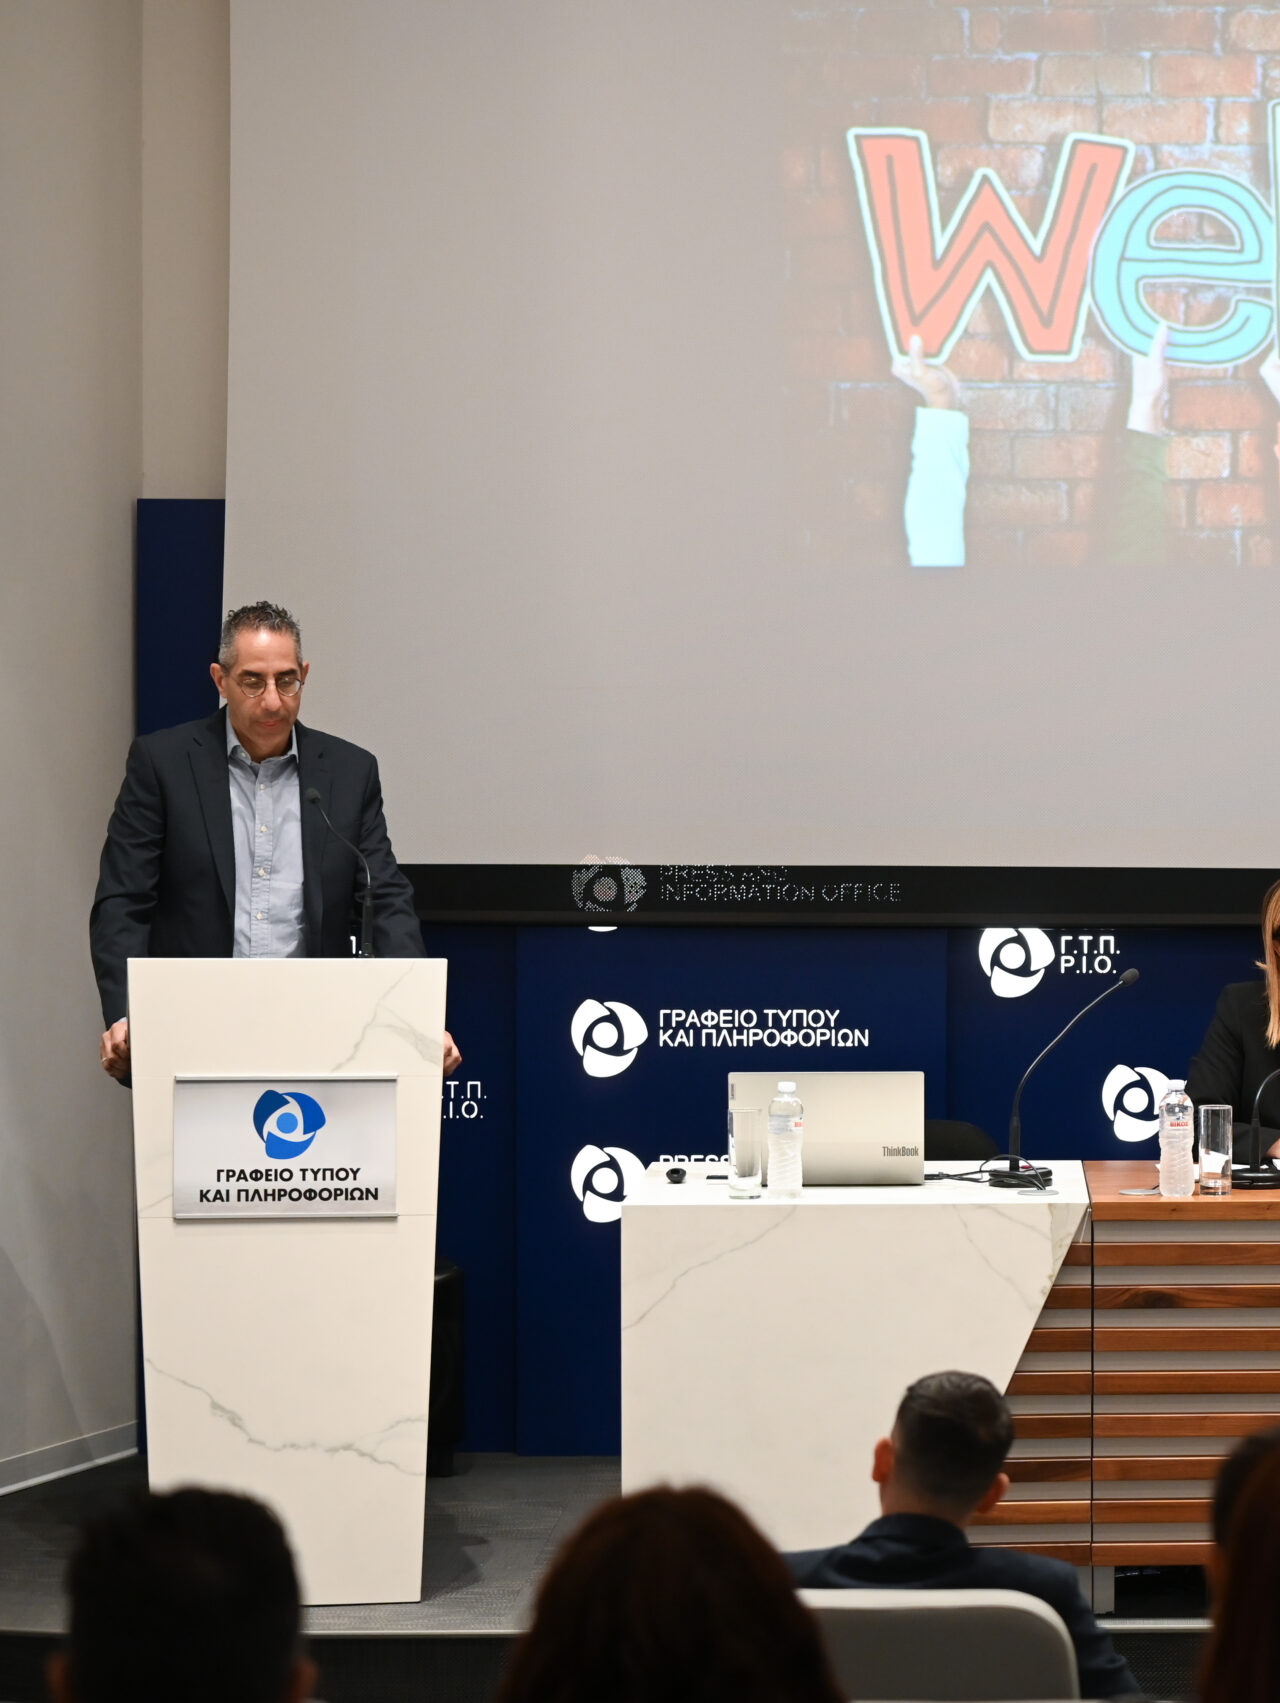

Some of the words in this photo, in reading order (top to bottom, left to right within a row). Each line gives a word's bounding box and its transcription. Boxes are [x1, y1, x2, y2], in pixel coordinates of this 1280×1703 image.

[1060, 935, 1120, 955] Γ.Τ.Π.
[1060, 955, 1117, 974] P.I.O.
[659, 1008, 758, 1028] ΓΡΑΦΕΙΟ
[763, 1008, 840, 1028] ΤΥΠΟΥ
[659, 1028, 694, 1047] ΚΑΙ
[701, 1028, 869, 1047] ΠΛΗΡΟΦΟΡΙΩΝ
[441, 1081, 487, 1099] .Τ.Π.
[443, 1100, 484, 1119] .I.O.
[882, 1145, 919, 1157] ThinkBook
[216, 1168, 294, 1183] ΓΡΑΦΕΙΟ
[299, 1167, 361, 1182] ΤΥΠΟΥ
[200, 1188, 230, 1203] ΚΑΙ
[236, 1187, 379, 1202] ΠΛΗΡΟΦΟΡΙΩΝ
